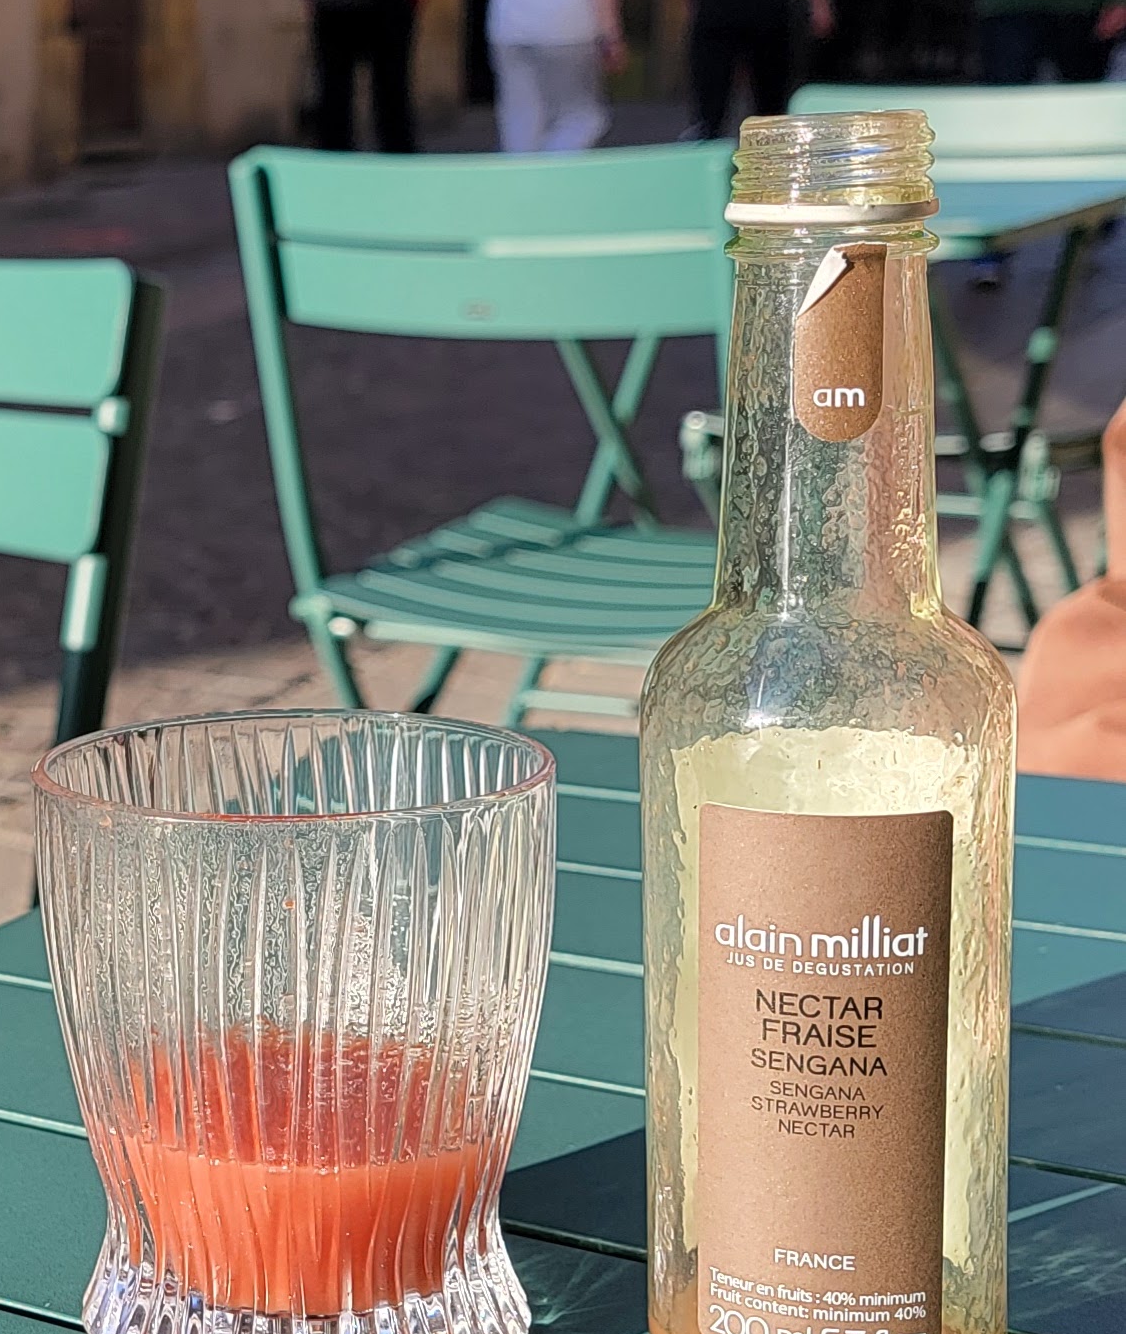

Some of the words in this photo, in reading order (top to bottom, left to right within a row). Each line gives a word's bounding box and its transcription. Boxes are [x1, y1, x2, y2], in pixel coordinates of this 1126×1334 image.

[812, 386, 865, 408] am
[714, 914, 802, 957] alain
[810, 915, 928, 959] milliat
[726, 951, 755, 968] JUS
[763, 957, 784, 972] DE
[792, 960, 914, 976] DEGUSTATION
[755, 988, 883, 1020] NECTAR
[762, 1018, 877, 1048] FRAISE
[750, 1048, 888, 1077] SENGANA
[769, 1080, 865, 1101] SENGANA
[751, 1095, 884, 1120] STRAWBERRY
[778, 1119, 855, 1138] NECTAR
[774, 1248, 855, 1271] FRANCE
[709, 1267, 754, 1292] Teneur
[756, 1284, 774, 1297] en
[777, 1284, 812, 1304] fruits
[822, 1291, 856, 1306] 40%
[859, 1290, 926, 1305] minimum
[710, 1282, 742, 1304] Fruit
[744, 1295, 809, 1319] content:
[813, 1307, 890, 1322] minimum
[894, 1305, 926, 1320] 40%
